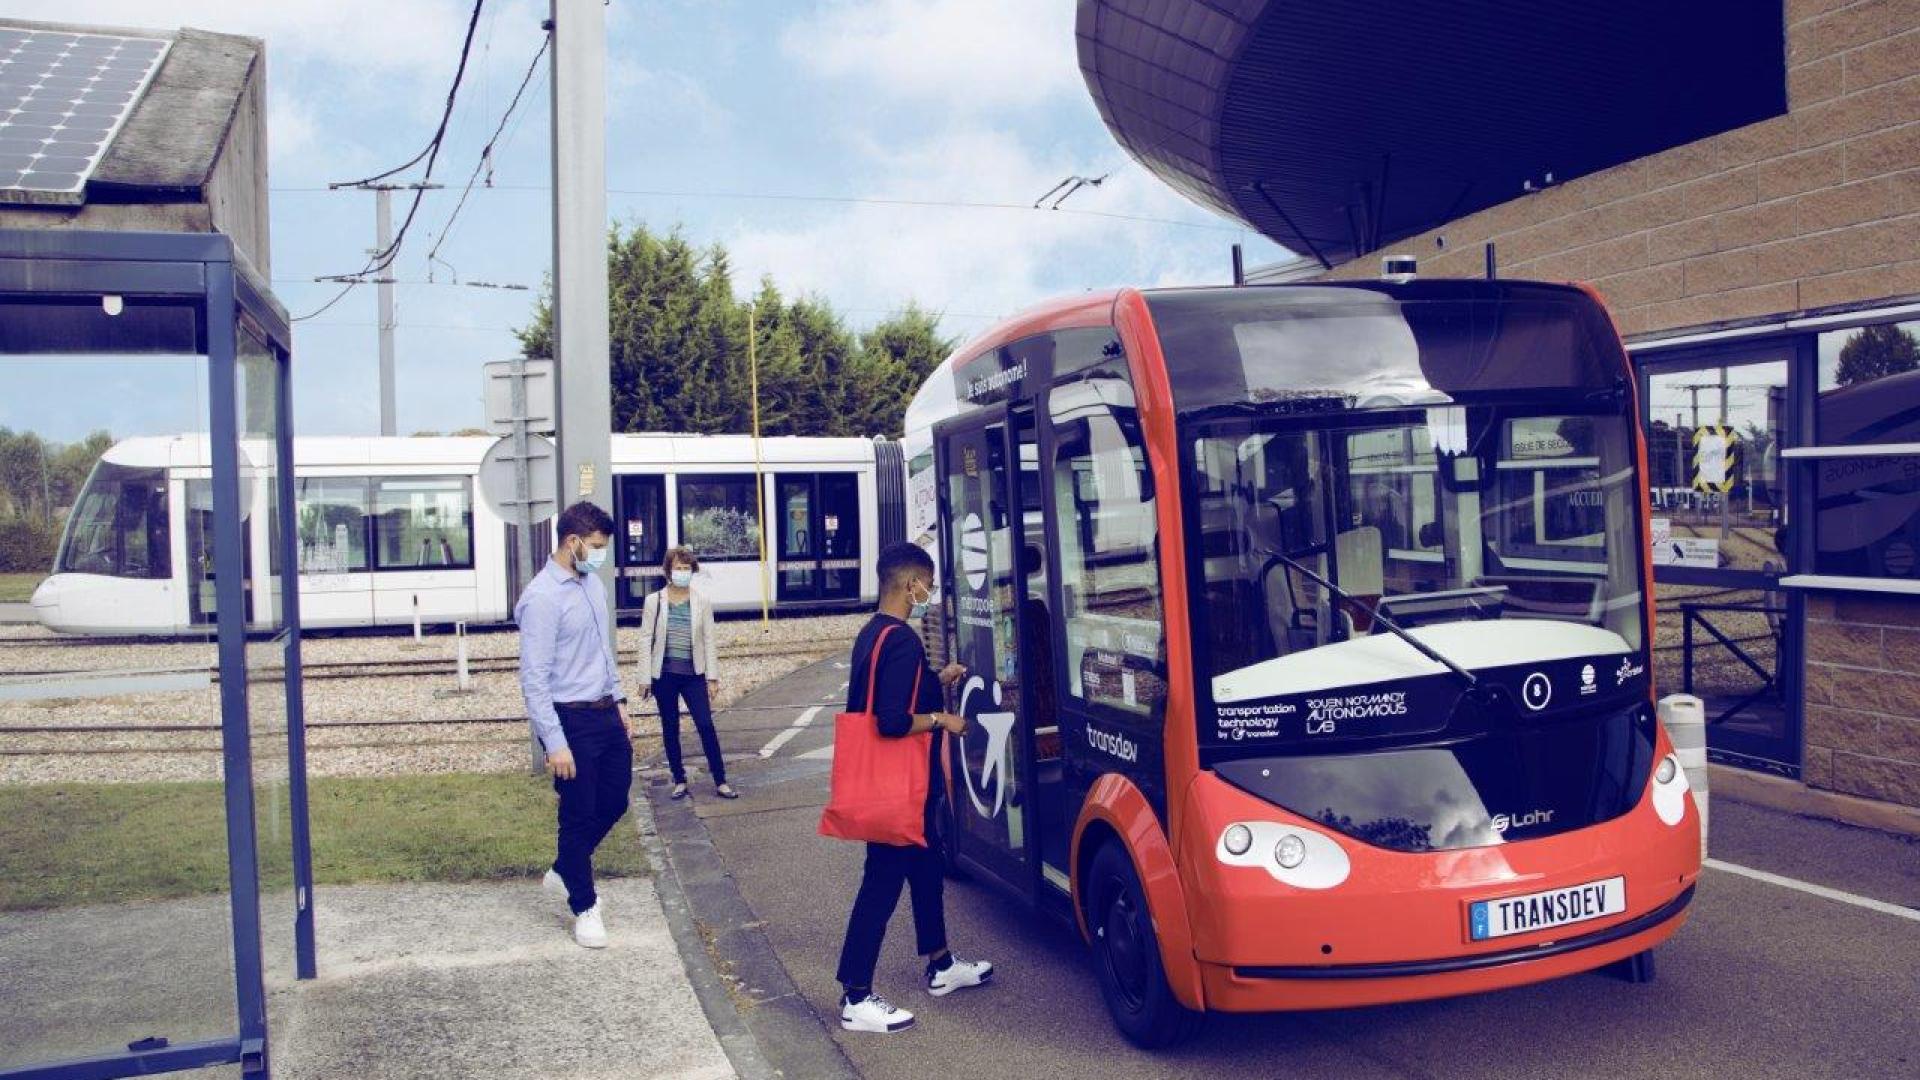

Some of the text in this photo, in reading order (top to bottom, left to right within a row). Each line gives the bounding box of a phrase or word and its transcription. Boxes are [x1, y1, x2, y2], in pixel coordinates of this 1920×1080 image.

[635, 567, 664, 576] VALID
[1305, 692, 1407, 709] ROUEN NORMANDY
[1217, 703, 1297, 717] transportation
[1306, 702, 1408, 721] AUTONOMOUS
[1217, 716, 1279, 729] technology
[1306, 720, 1336, 734] LAB
[1086, 722, 1138, 763] transdev
[1511, 809, 1554, 828] Lohr
[1498, 885, 1606, 931] TRANSDEV
